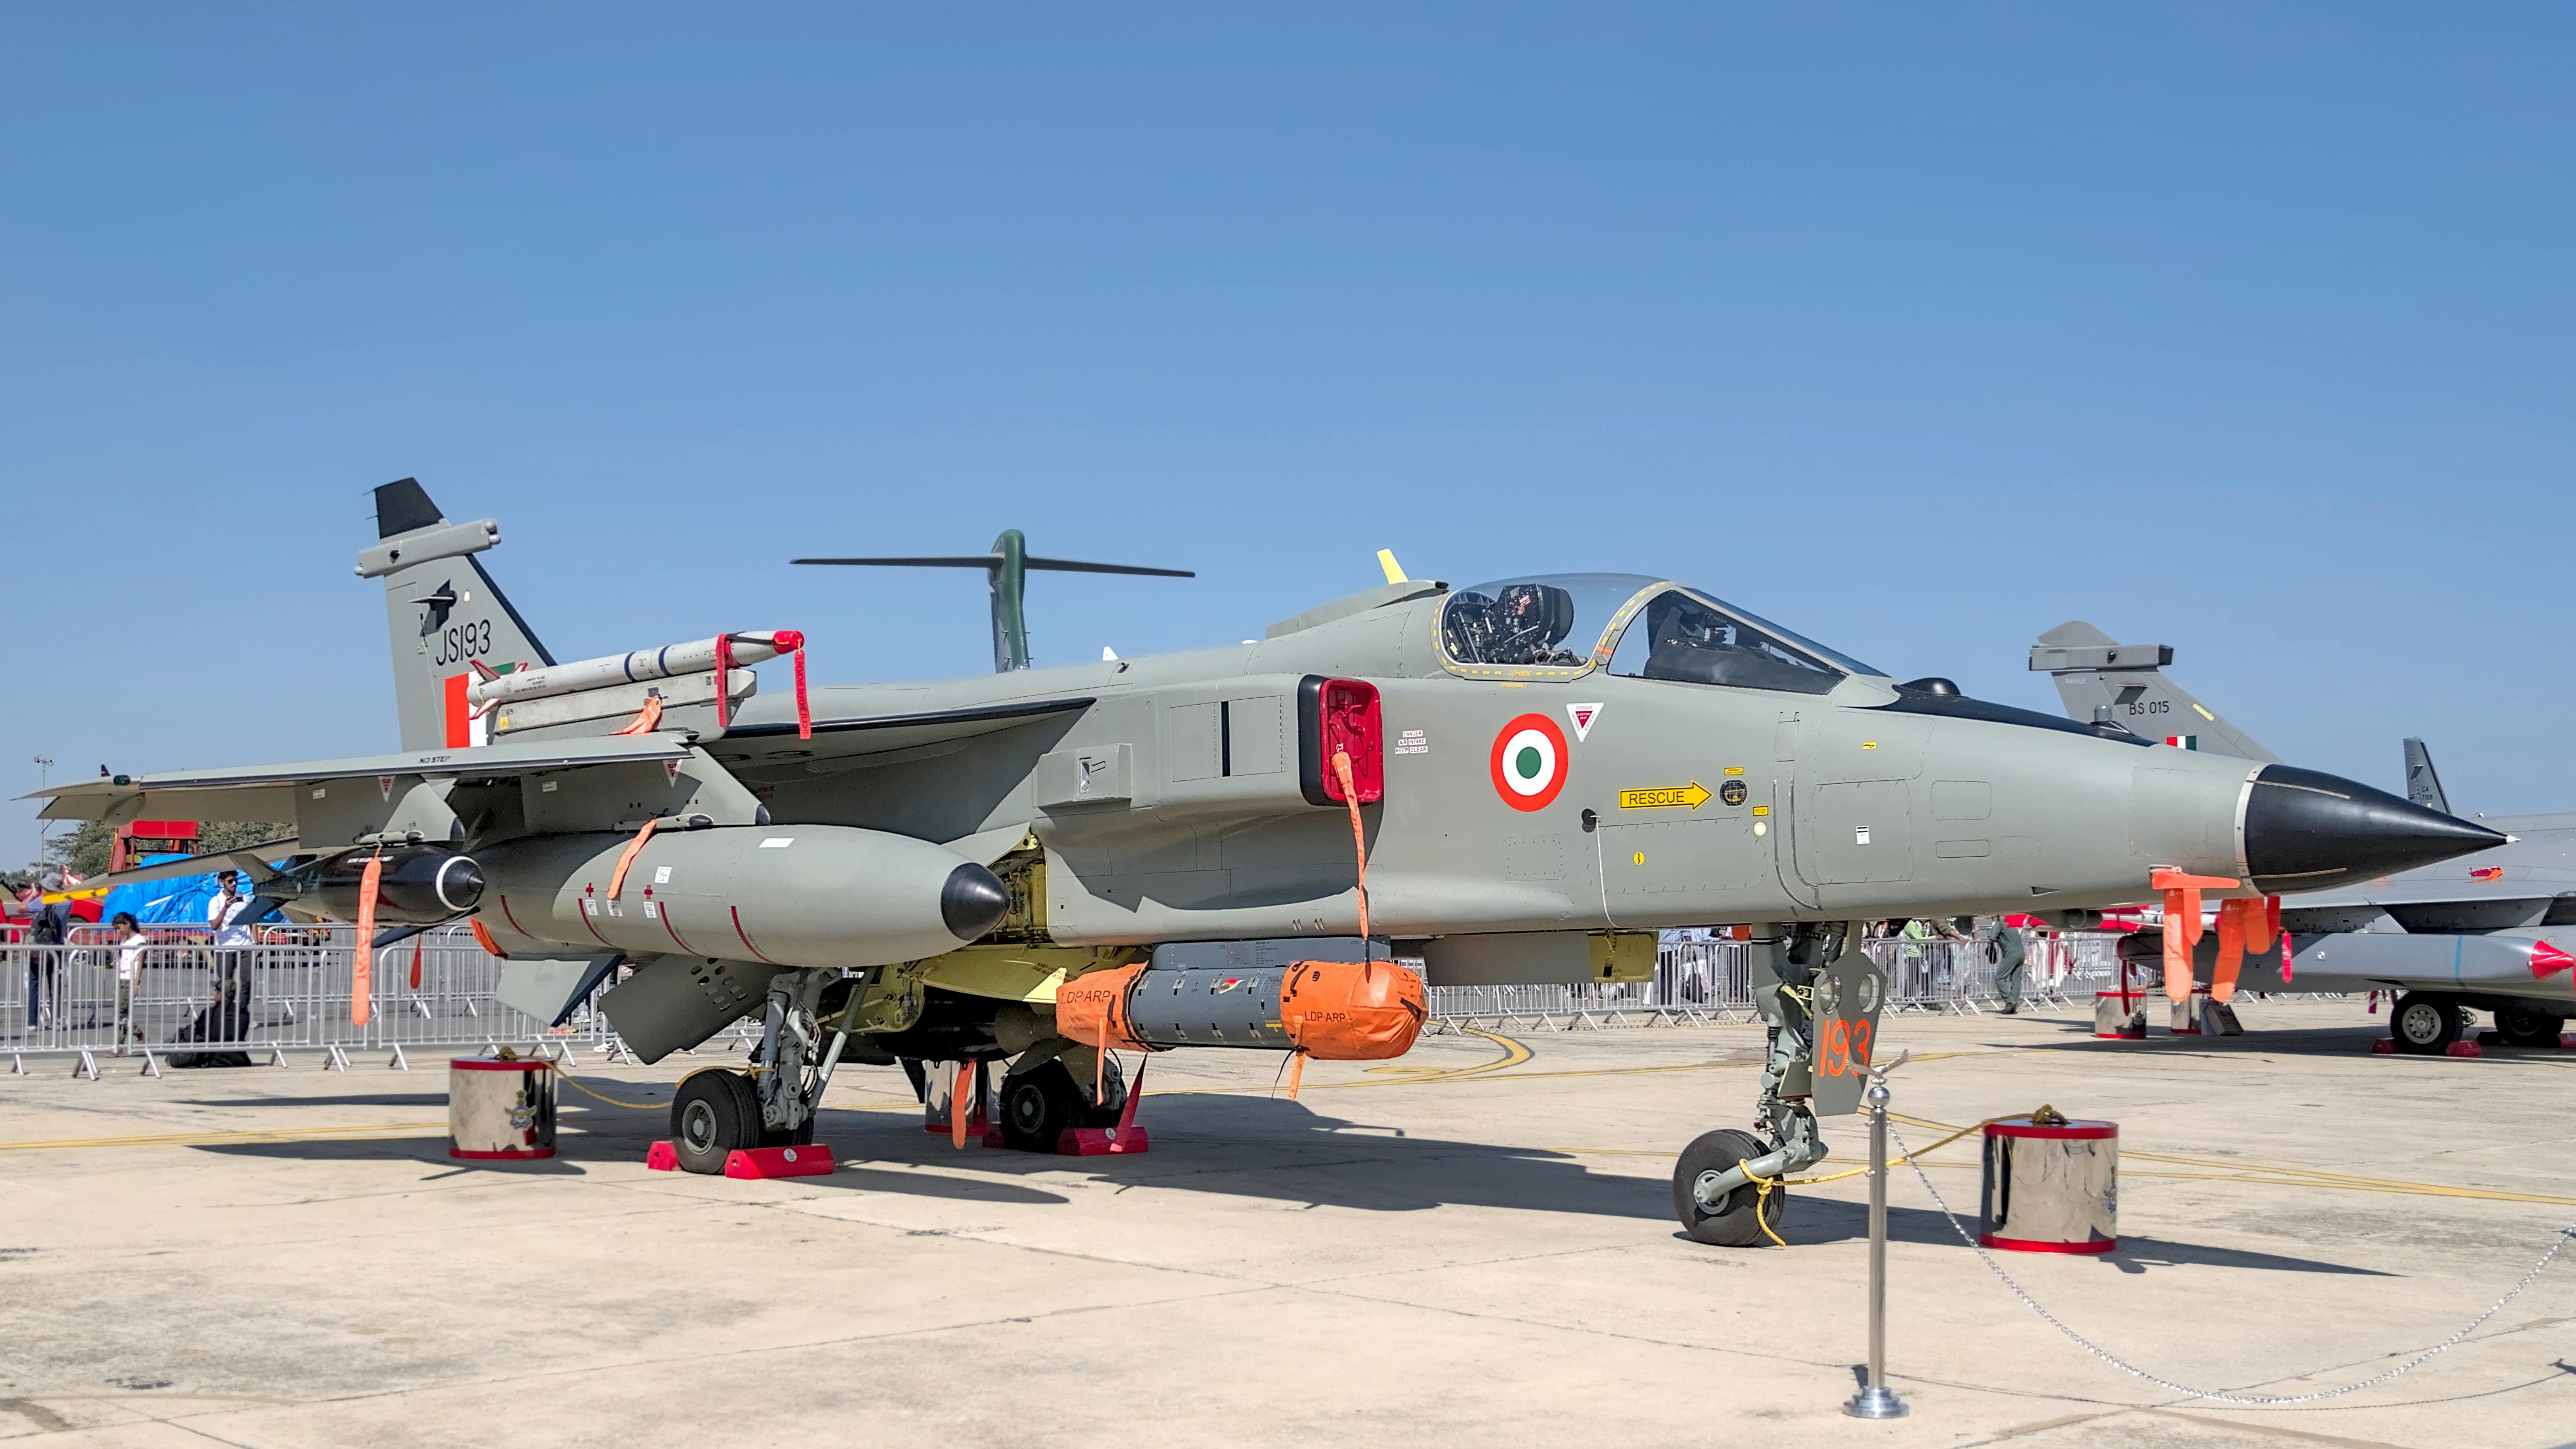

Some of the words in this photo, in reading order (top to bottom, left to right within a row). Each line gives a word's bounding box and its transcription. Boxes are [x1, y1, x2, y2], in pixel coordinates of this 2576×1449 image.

[435, 619, 491, 666] JS193
[2129, 703, 2144, 715] BS
[2149, 701, 2169, 713] 015
[1629, 791, 1684, 805] RESCUE
[1819, 1019, 1870, 1077] 193
